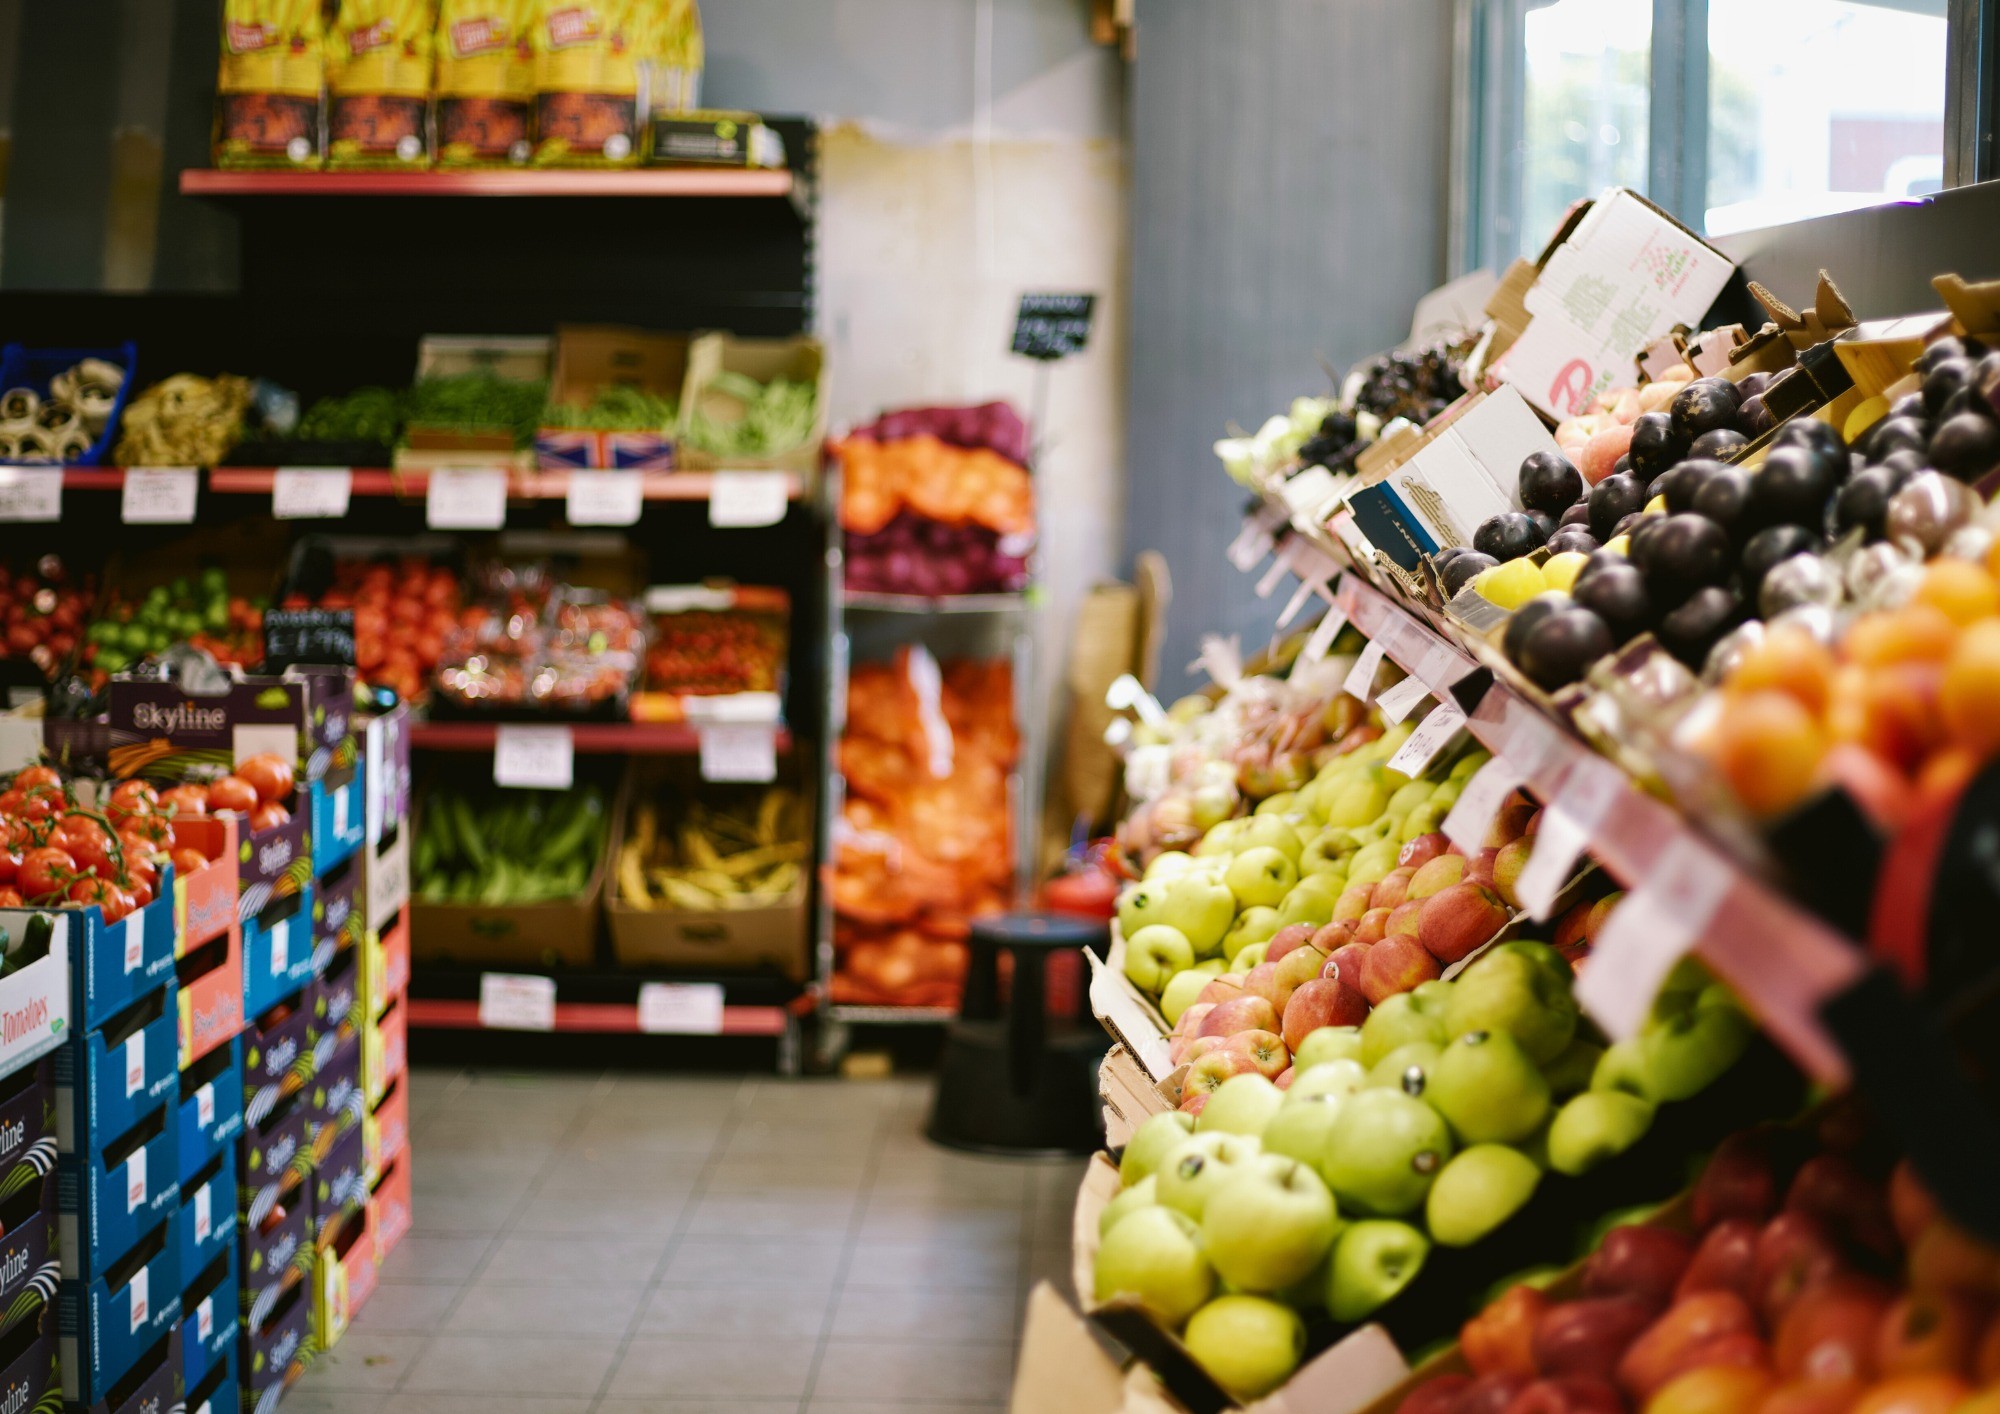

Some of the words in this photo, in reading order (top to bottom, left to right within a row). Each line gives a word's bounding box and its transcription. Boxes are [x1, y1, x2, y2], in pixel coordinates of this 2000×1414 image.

[133, 701, 226, 736] Skyline
[2, 996, 48, 1046] Tomatoes
[0, 1119, 24, 1156] line
